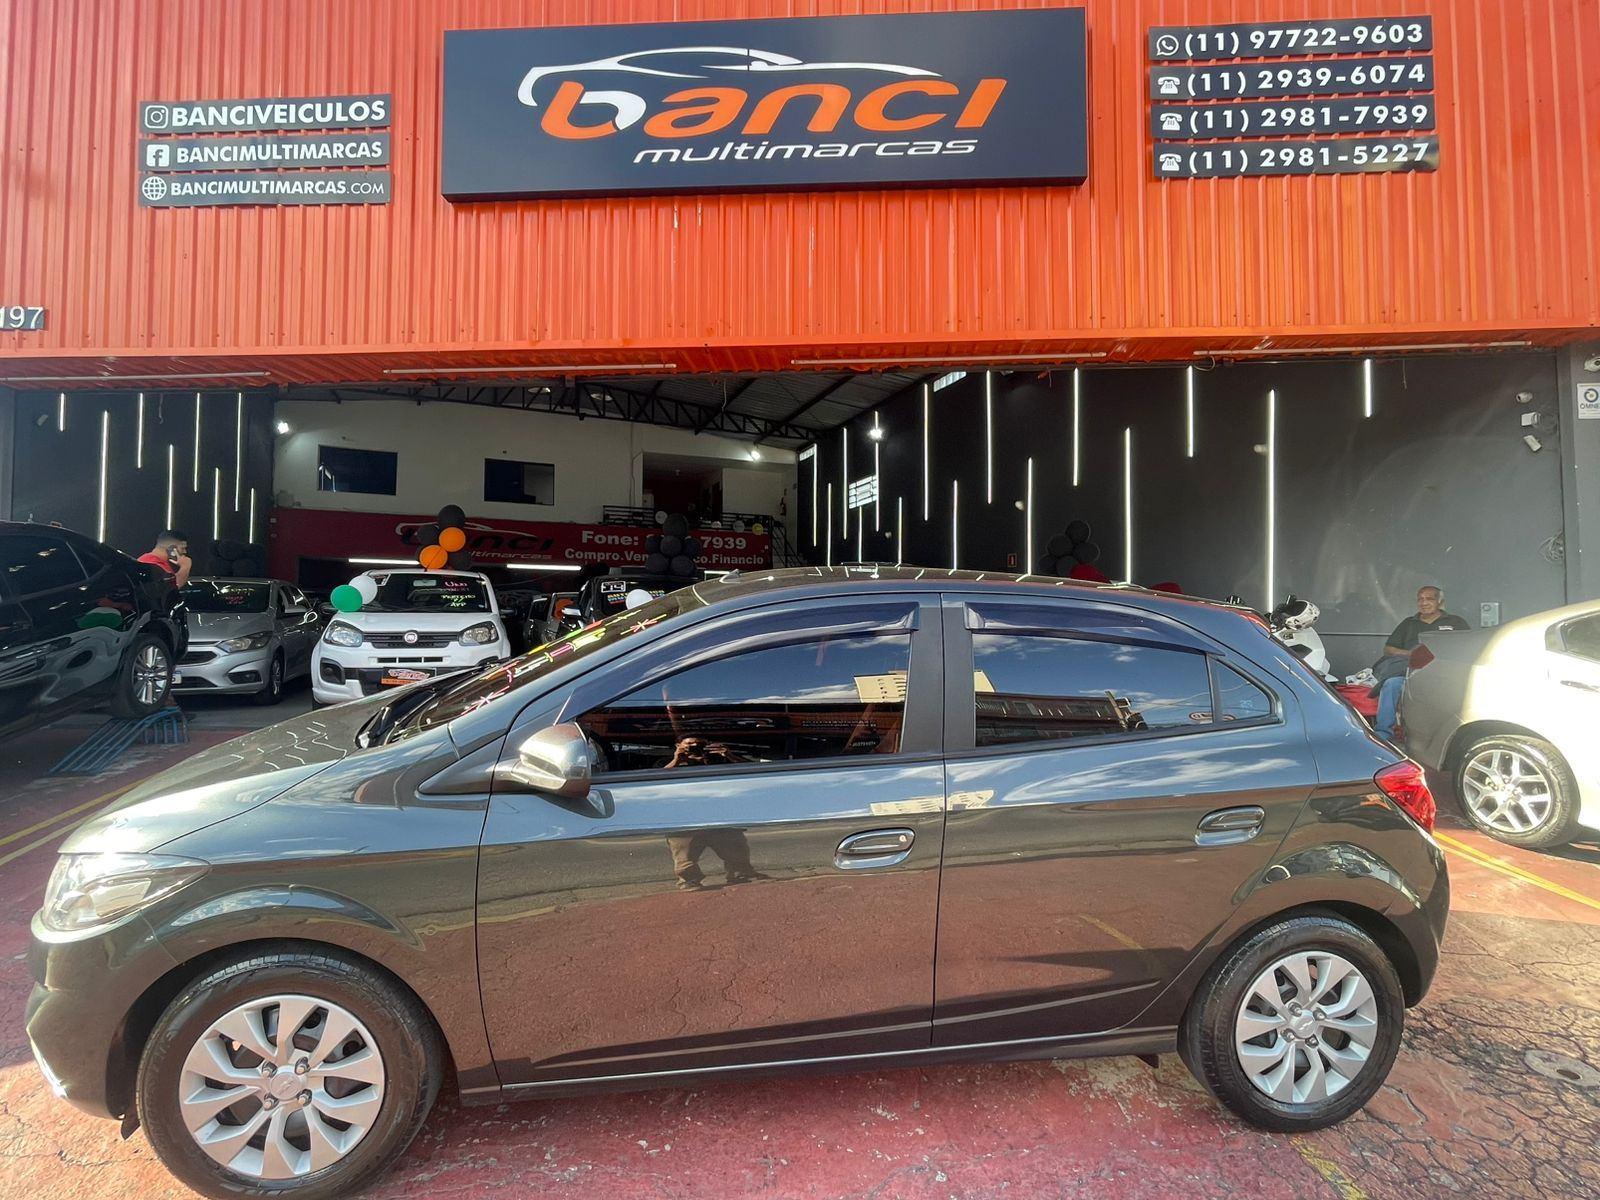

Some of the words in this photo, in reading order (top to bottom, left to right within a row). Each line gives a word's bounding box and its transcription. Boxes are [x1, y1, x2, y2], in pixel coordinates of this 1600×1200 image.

[1185, 31, 1240, 57] (11)
[1250, 23, 1423, 50] 97722-9603
[1187, 71, 1246, 97] (11)
[1258, 63, 1425, 90] 2939-6074
[171, 100, 386, 127] BANCIVEICULOS
[1190, 109, 1249, 134] (11)
[1260, 104, 1428, 128] 2981-7939
[176, 140, 382, 164] BANCIMULTIMARCAS
[633, 137, 978, 165] multimarcas
[1189, 150, 1248, 174] (11)
[1259, 142, 1429, 168] 2981-5227
[170, 180, 385, 197] BANCIMULTIMARCAS.COM
[0, 305, 44, 329] 197
[582, 530, 639, 546] Fone:
